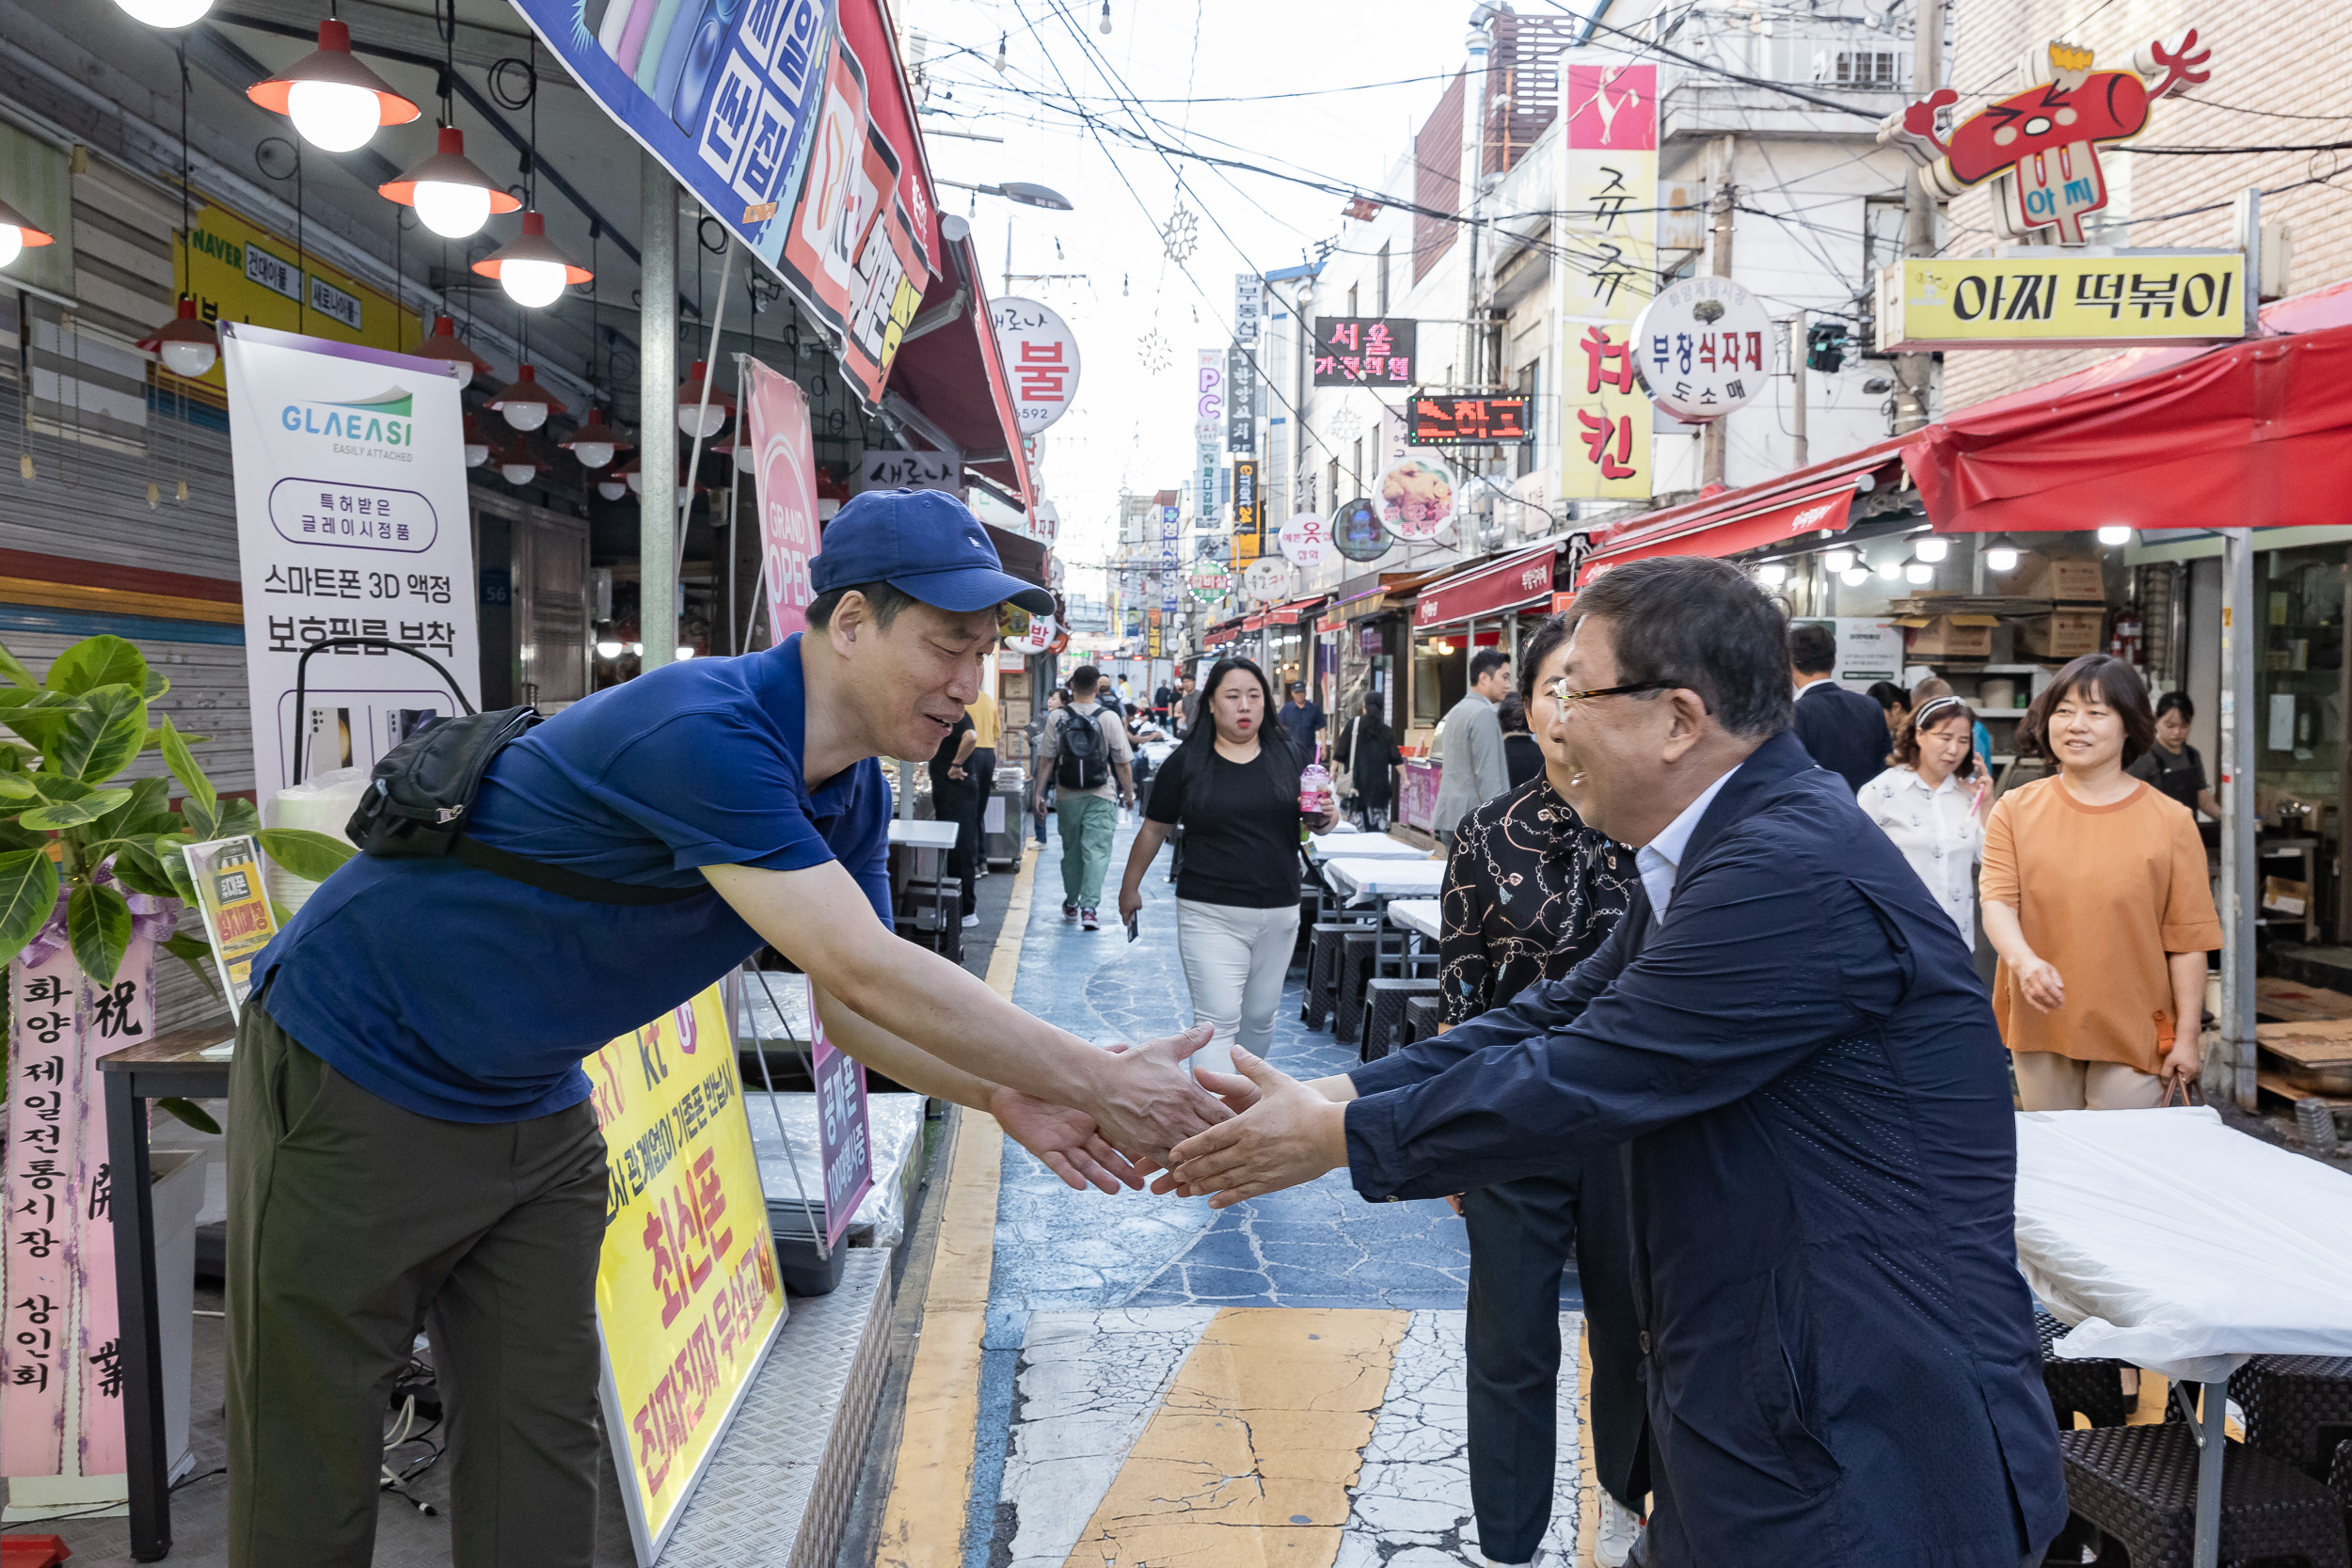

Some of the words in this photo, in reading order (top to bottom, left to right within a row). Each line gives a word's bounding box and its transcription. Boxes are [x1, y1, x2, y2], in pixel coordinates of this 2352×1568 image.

[193, 229, 242, 270] NAVER
[2075, 272, 2233, 320] 떡볶이
[1327, 323, 1394, 356] 서울
[1652, 331, 1762, 375] 부창식자재
[997, 341, 1070, 402] 불
[1672, 379, 1746, 404] 도소매
[1199, 367, 1221, 420] PC
[281, 405, 412, 447] GLAEASI
[333, 443, 365, 455] EASILY
[366, 449, 413, 463] ATTACHED
[869, 457, 954, 485] 새로나
[321, 493, 390, 516] 특허받은
[769, 500, 805, 546] GRAND
[301, 515, 410, 541] 글레이시정품
[264, 564, 362, 599] 스마트폰
[369, 572, 401, 599] 3D
[407, 574, 452, 604] 액정
[768, 543, 819, 607] OPEN
[268, 614, 389, 656] 보호필름
[399, 620, 455, 657] 부착
[92, 979, 144, 1039] 祝
[643, 1145, 734, 1330] 최신폰
[11, 1294, 60, 1394] 상인회
